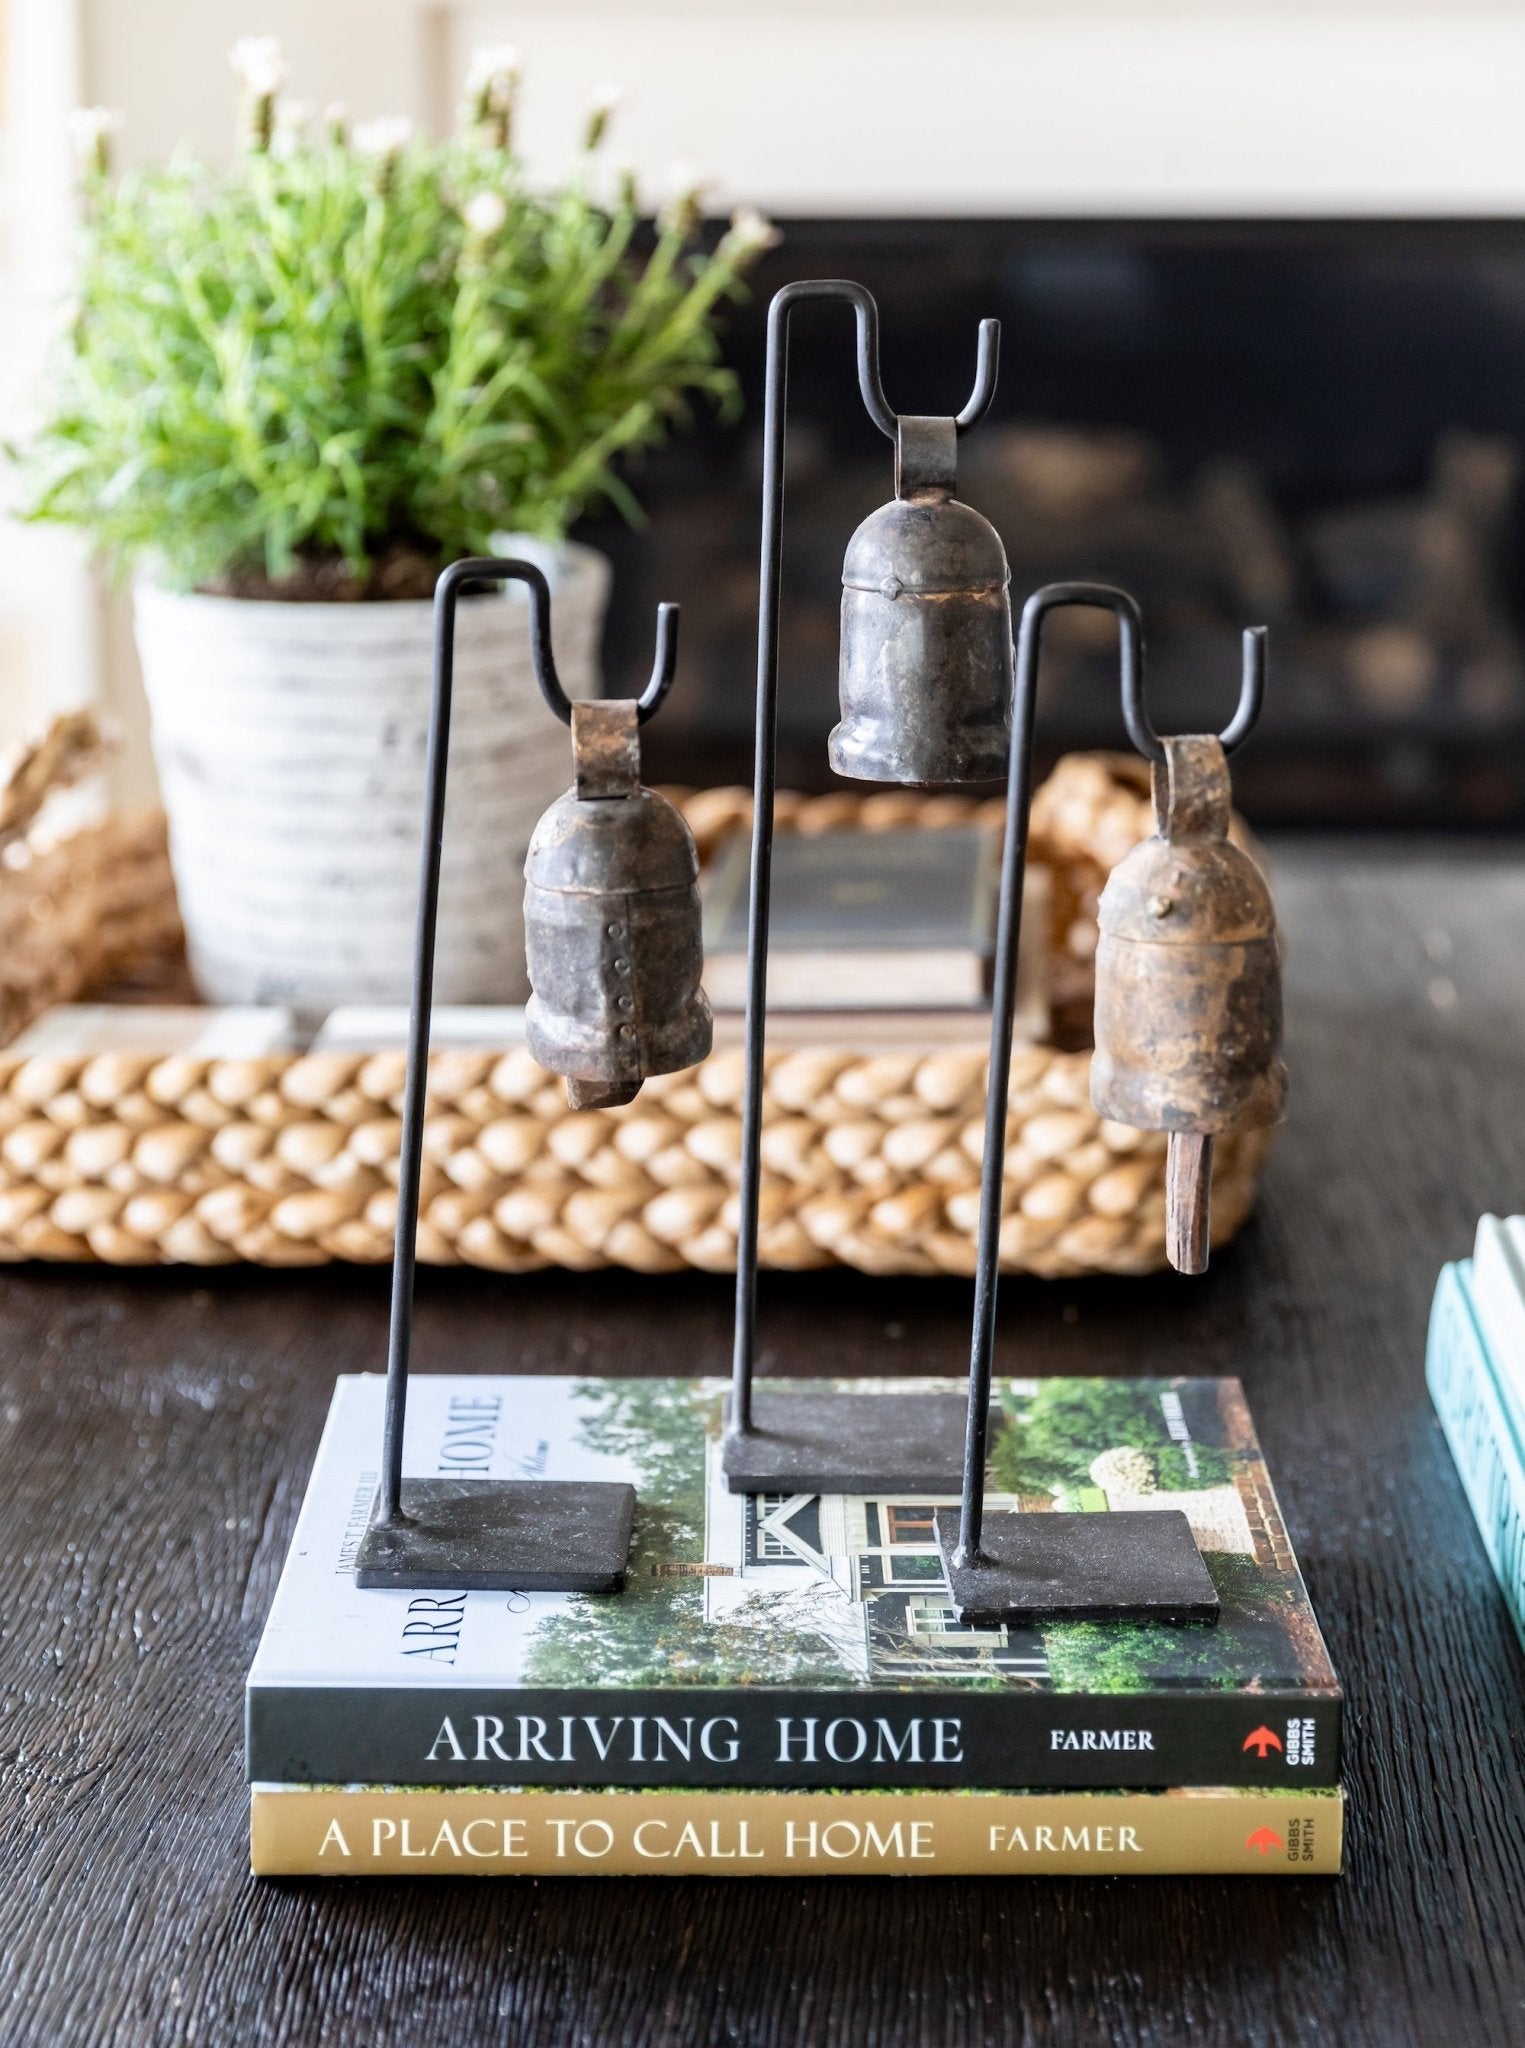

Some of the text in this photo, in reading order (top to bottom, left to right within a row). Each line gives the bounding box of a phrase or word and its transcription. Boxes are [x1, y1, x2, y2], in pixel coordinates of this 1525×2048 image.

[399, 1590, 468, 1666] ARR
[424, 1715, 964, 1764] ARRIVING HOME
[1050, 1729, 1156, 1751] FARMER
[1286, 1717, 1301, 1766] GIBBS
[1301, 1717, 1316, 1766] SMITH
[318, 1818, 936, 1859] A PLACE TO CALL HOME
[989, 1825, 1143, 1852] FARMER
[1287, 1818, 1300, 1862] GIBBS
[1302, 1818, 1315, 1862] SMITH
